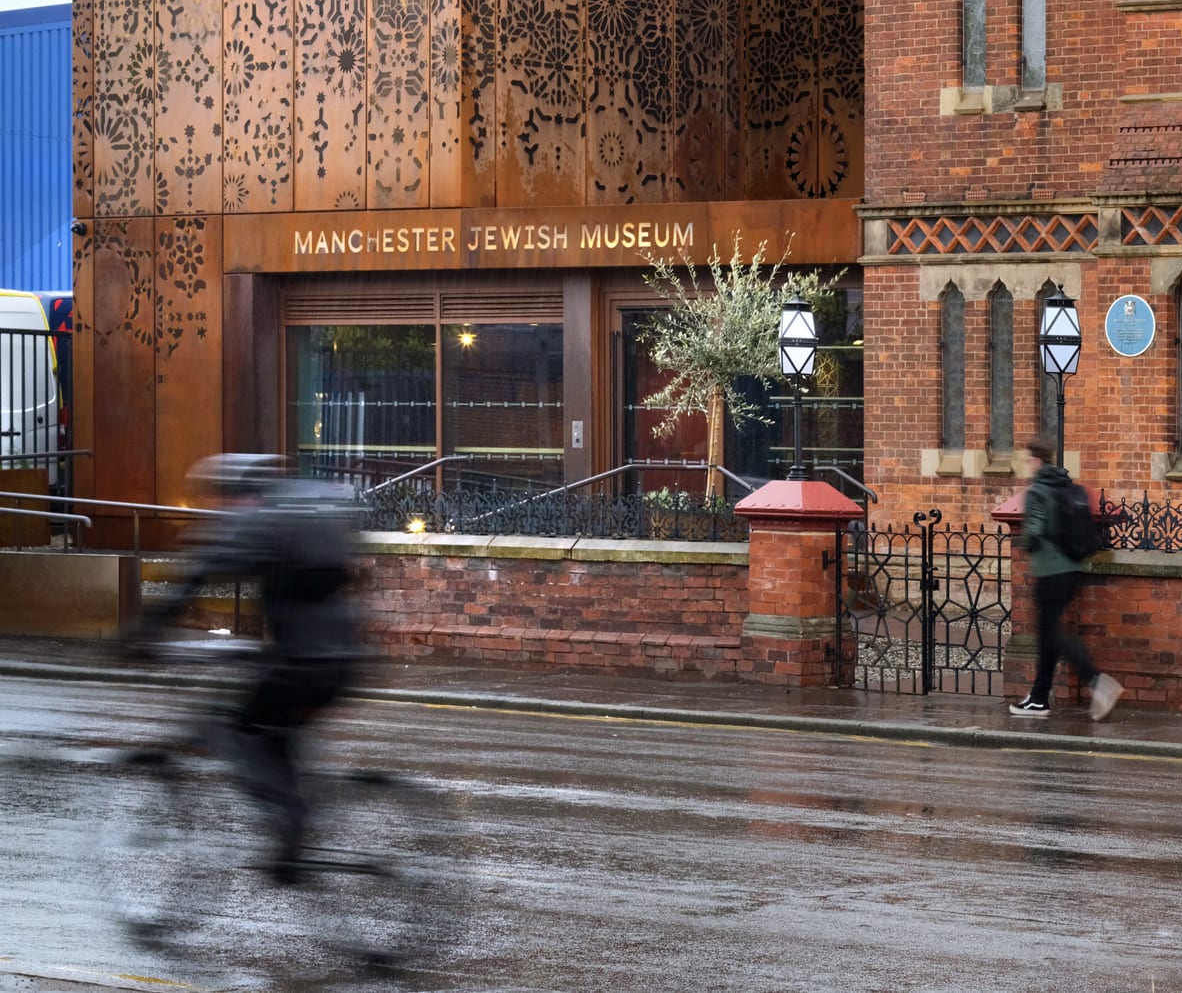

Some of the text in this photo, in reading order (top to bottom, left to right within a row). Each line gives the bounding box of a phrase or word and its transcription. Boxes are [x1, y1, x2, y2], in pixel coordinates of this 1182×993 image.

[294, 222, 694, 254] MANCHESTER JEWISH MUSEUM
